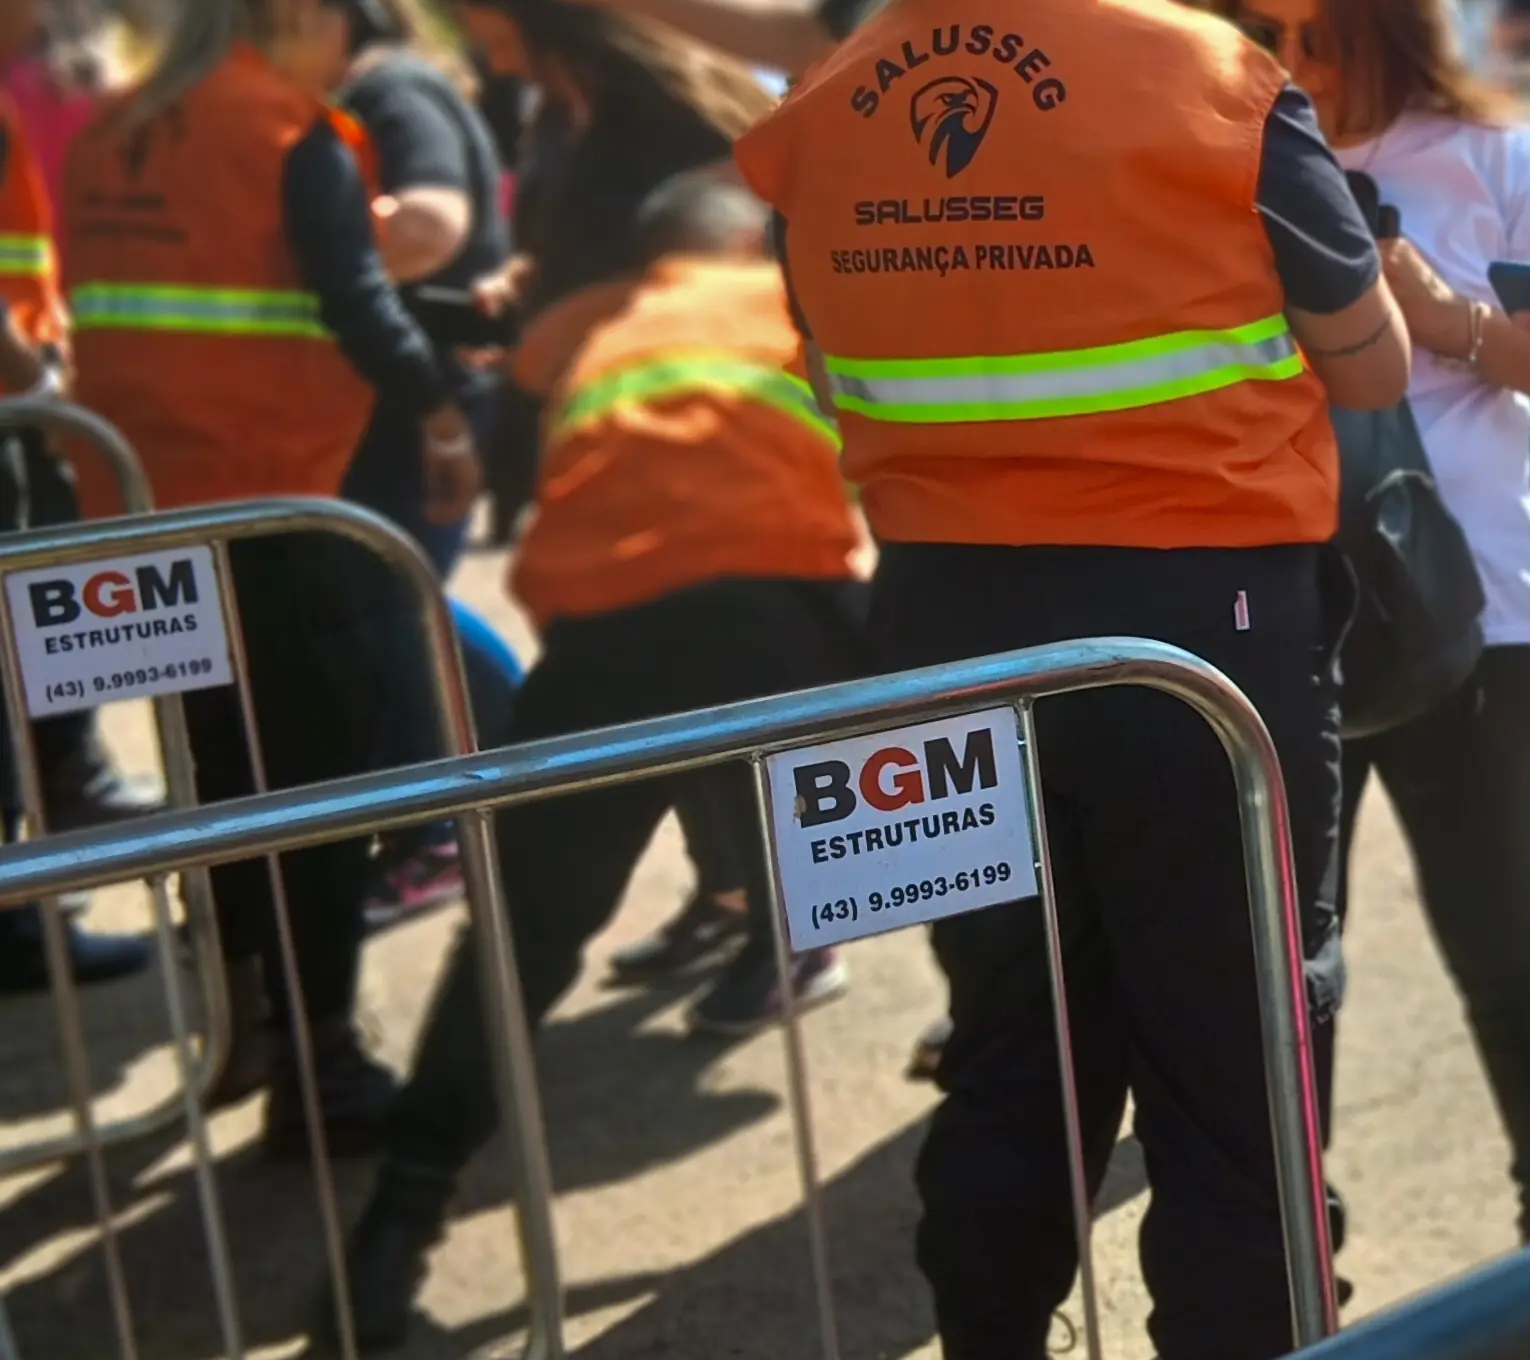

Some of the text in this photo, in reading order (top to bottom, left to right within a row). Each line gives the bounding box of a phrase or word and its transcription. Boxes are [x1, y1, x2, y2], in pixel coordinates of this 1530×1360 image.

[851, 24, 1066, 118] SALUSSEG
[855, 195, 1044, 225] SALUSSEG
[831, 244, 1095, 277] SEGURANÇA PRIVADA
[28, 558, 198, 628] BGM
[45, 614, 197, 654] ESTRUTURAS
[46, 658, 212, 702] (43) 9.9993-6199
[793, 727, 998, 829] BGM
[811, 803, 995, 864] ESTRUTURAS
[812, 862, 1011, 930] (43) 9.9993-6199
